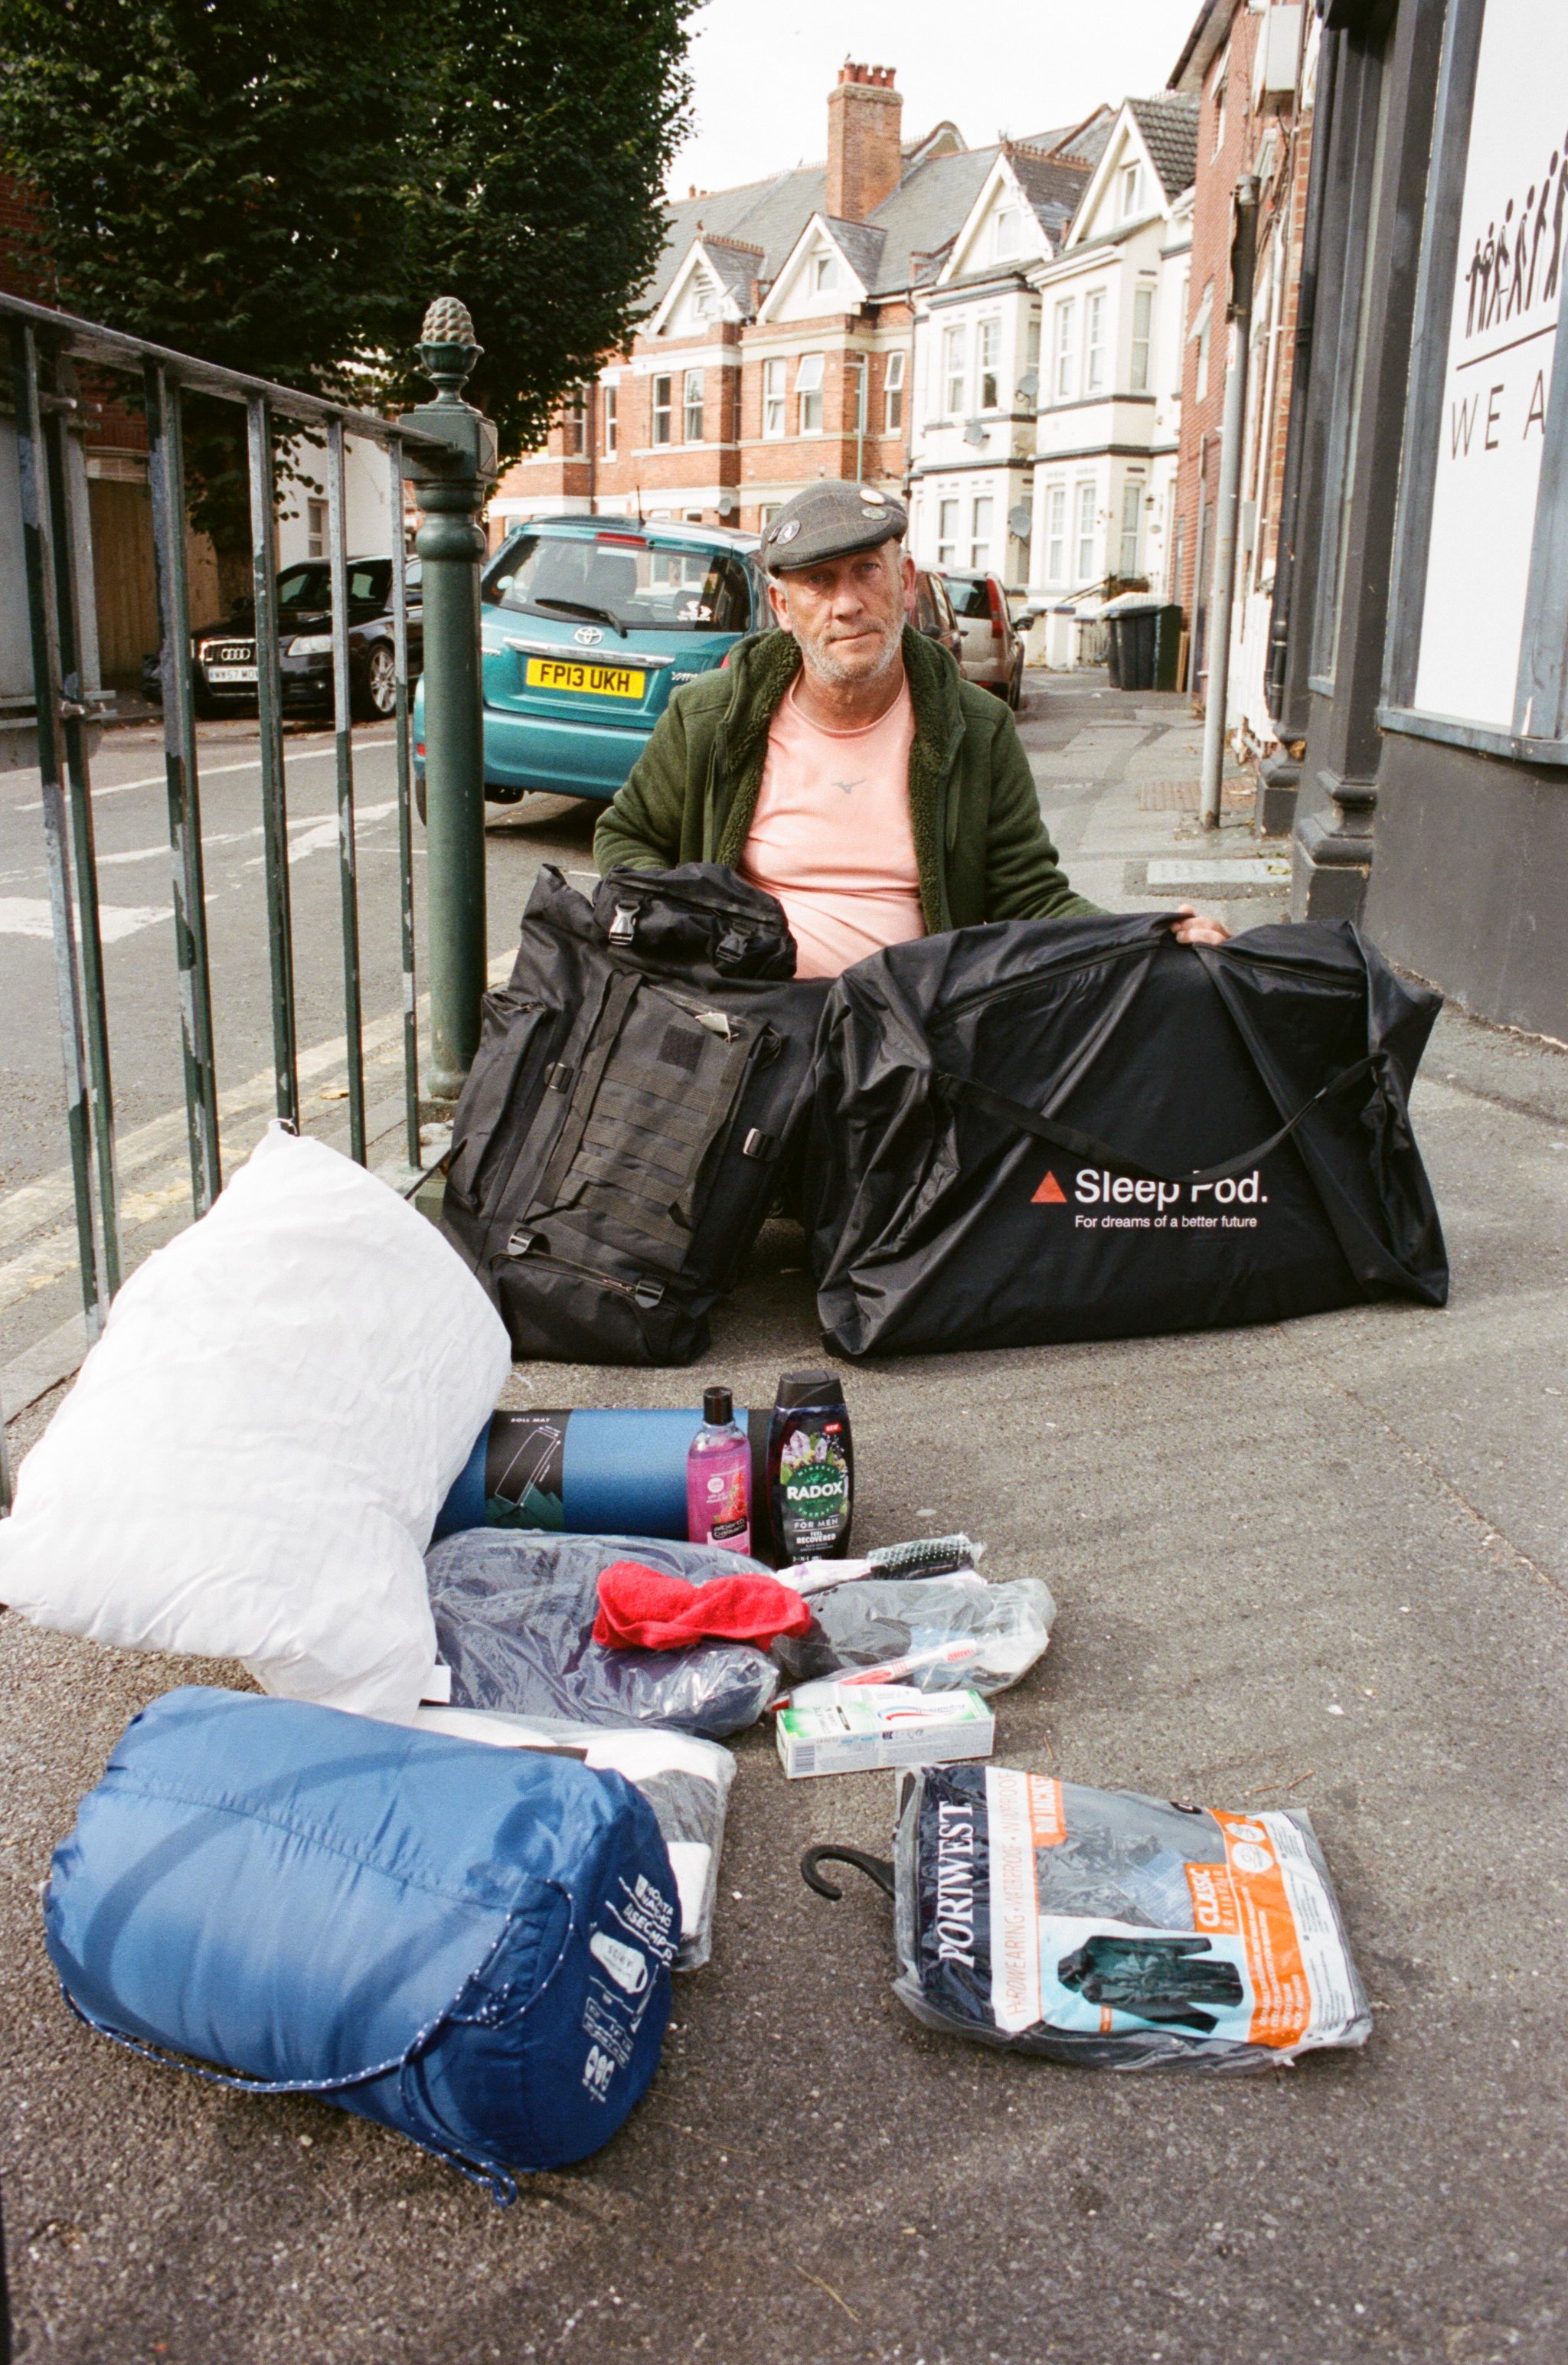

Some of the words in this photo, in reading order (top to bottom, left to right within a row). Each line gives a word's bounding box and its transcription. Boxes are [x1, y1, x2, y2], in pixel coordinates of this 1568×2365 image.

[1452, 384, 1504, 459] WE
[540, 663, 585, 687] FP13
[590, 671, 629, 693] UKH
[1074, 1168, 1180, 1211] Sleep
[1075, 1215, 1098, 1228] For
[1101, 1215, 1150, 1228] dreams
[1154, 1215, 1168, 1228] of
[1170, 1218, 1178, 1228] a
[1181, 1215, 1218, 1228] better
[1221, 1215, 1258, 1228] future
[797, 1465, 835, 1477] MINERAL
[786, 1480, 843, 1501] RADOX
[794, 1521, 815, 1530] FOR
[818, 1517, 838, 1527] MEN
[798, 1504, 835, 1517] THERAPY
[796, 1533, 836, 1544] RECOVERED
[998, 1772, 1020, 1833] WINDPROOF
[936, 1800, 975, 1968] PORTWEST
[1001, 1844, 1024, 1906] WATERPROOF
[1189, 1868, 1220, 1927] CLASSIC
[1004, 1915, 1027, 2016] HARDWEARING
